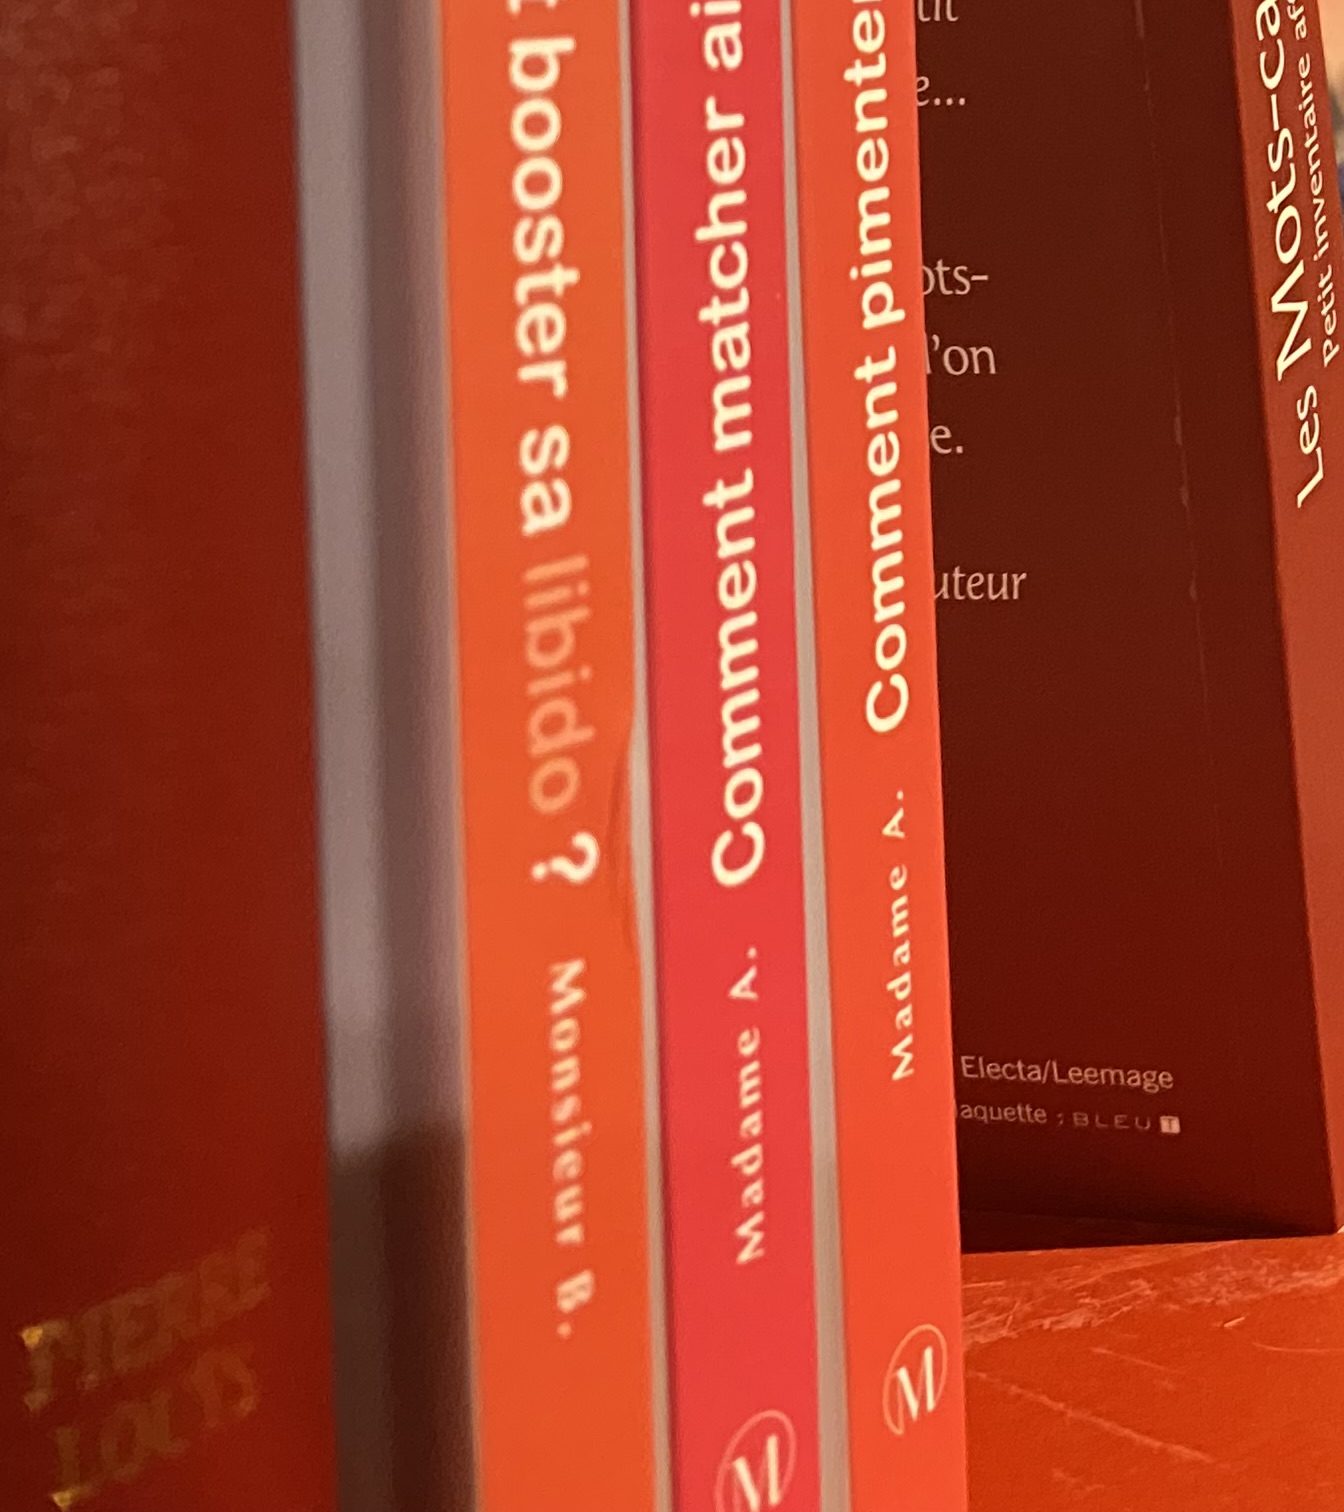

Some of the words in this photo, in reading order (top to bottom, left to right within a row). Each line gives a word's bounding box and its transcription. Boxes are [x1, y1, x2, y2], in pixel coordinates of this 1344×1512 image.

[508, 36, 581, 400] booster
[1297, 52, 1332, 264] inventaire
[695, 96, 755, 454] matcher
[1317, 264, 1341, 369] Petit
[518, 424, 573, 538] sa
[1295, 384, 1325, 509] Les
[852, 345, 911, 734] Comment
[521, 552, 597, 814] libido
[709, 464, 767, 888] Comment
[530, 830, 601, 885] ?
[882, 789, 906, 840] A.
[728, 943, 760, 1004] A.
[884, 863, 916, 1082] Madame
[549, 956, 593, 1248] Monsieur
[728, 1025, 767, 1267] Madame
[959, 1054, 1175, 1094] Electa/Leemage
[1072, 1111, 1151, 1131] BLEU
[555, 1268, 595, 1341] B.
